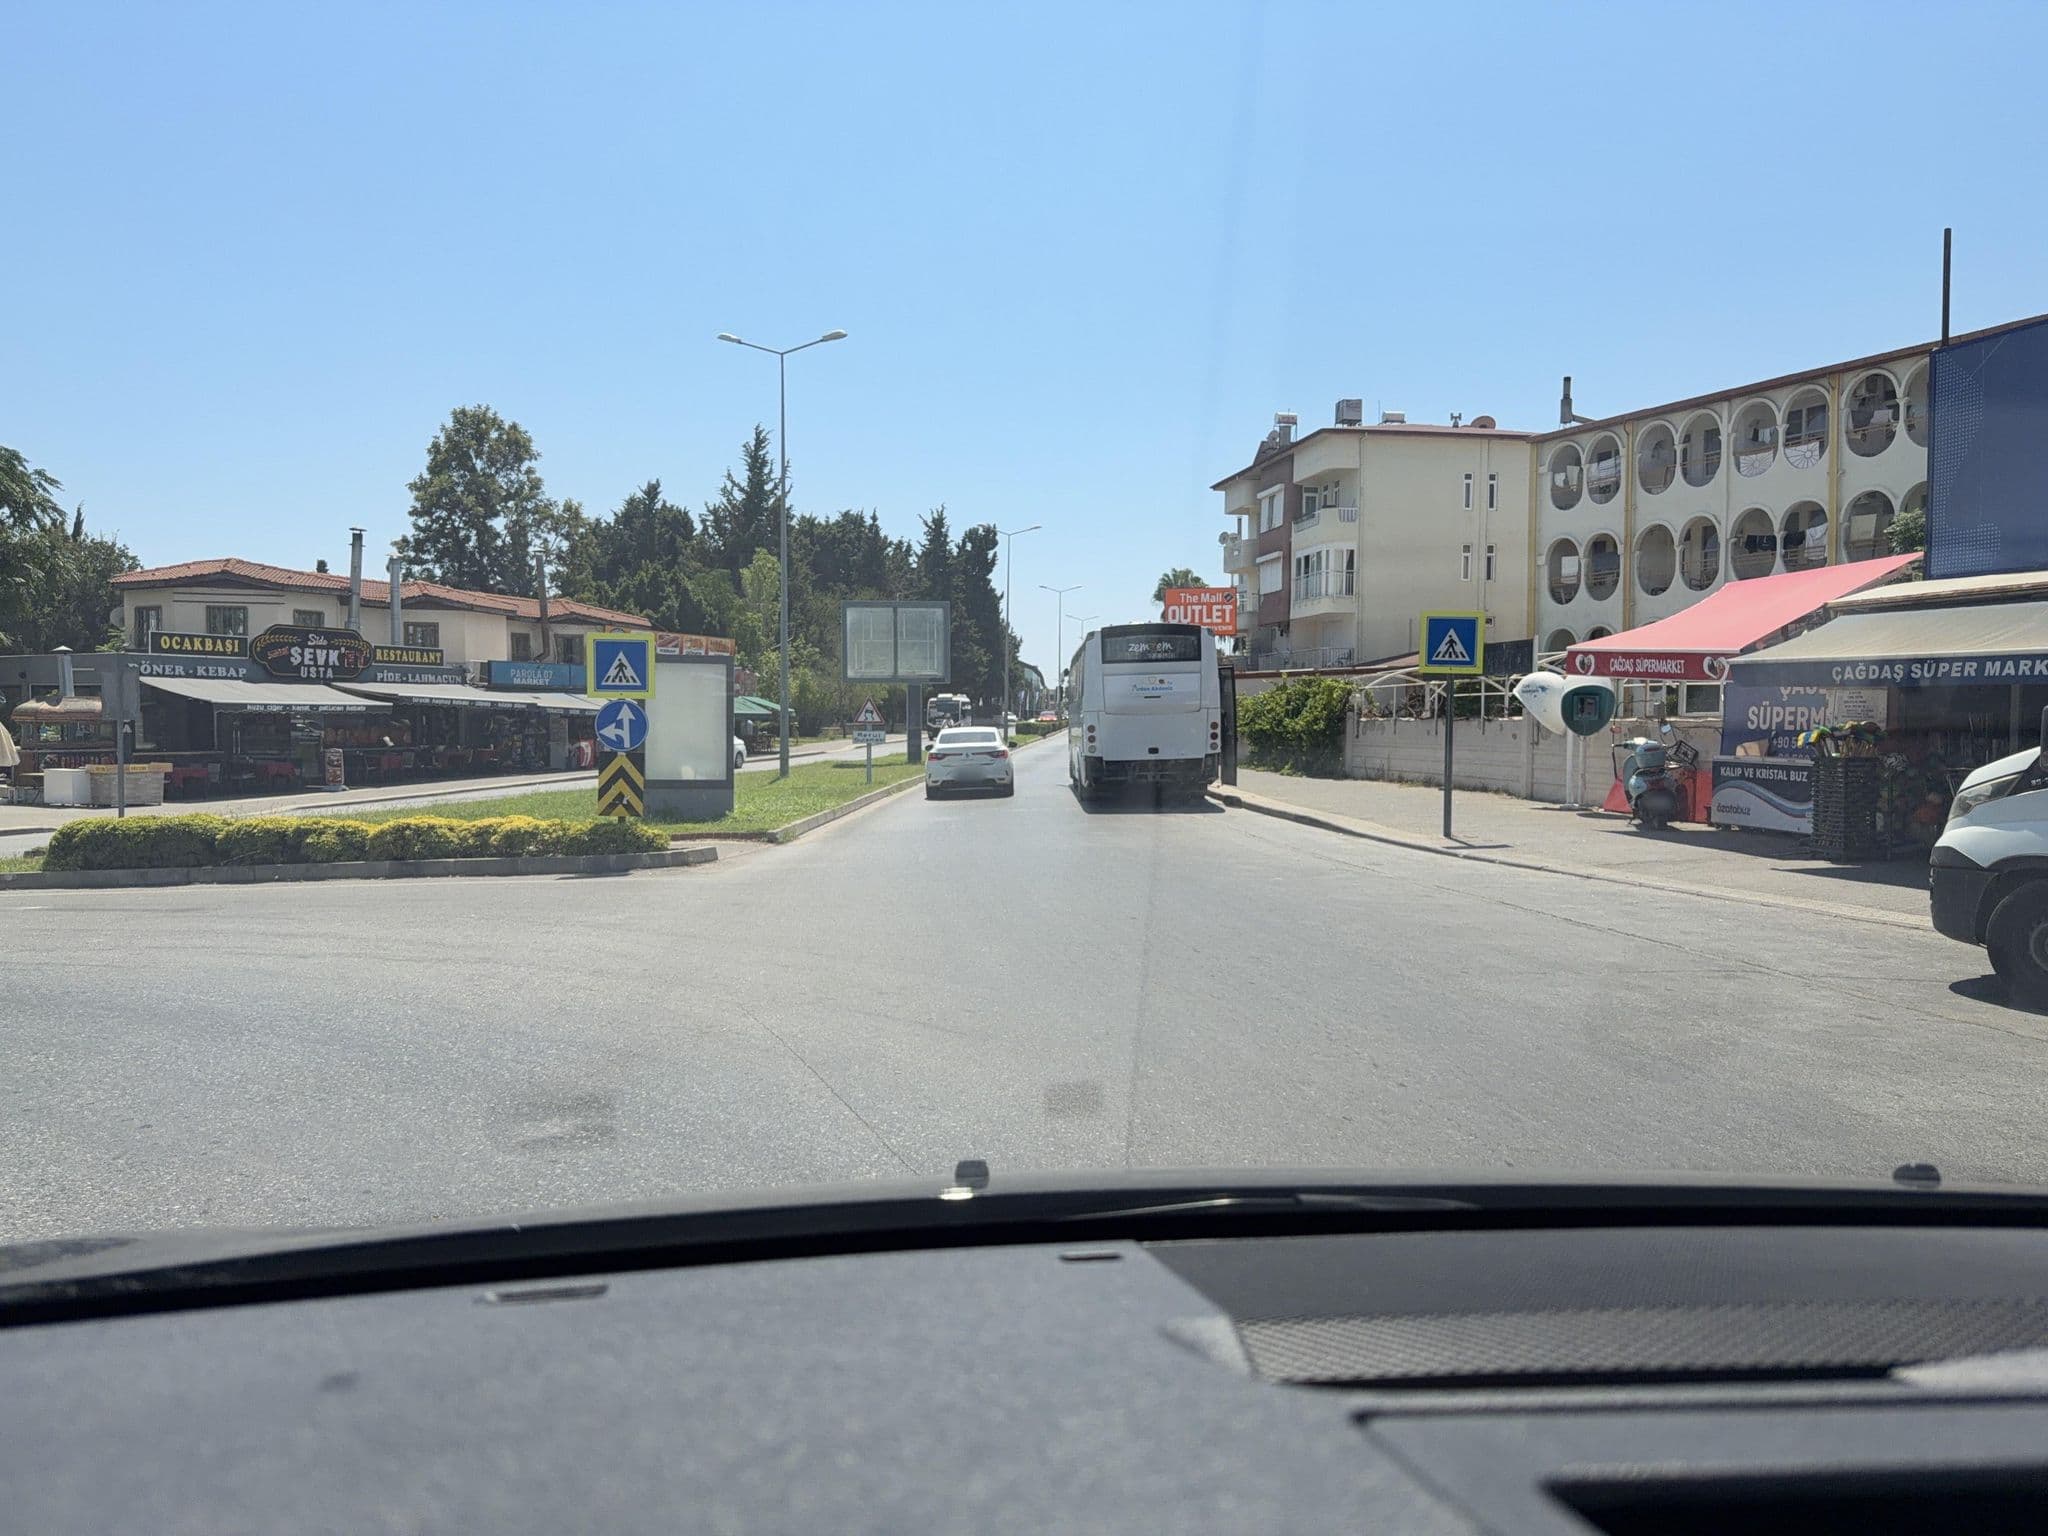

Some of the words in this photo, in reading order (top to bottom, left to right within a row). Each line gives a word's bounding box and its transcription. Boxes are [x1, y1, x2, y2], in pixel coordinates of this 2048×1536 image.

[1180, 592, 1198, 603] The
[1200, 592, 1222, 603] Mall
[1168, 604, 1233, 624] OUTLET
[160, 635, 240, 655] OCAKBAŞI
[375, 648, 442, 664] RESTAURANT
[196, 665, 247, 678] KEBAP
[300, 666, 334, 679] USTA
[1609, 655, 1634, 674] ÇAĞDAŞ
[1635, 656, 1685, 674] SÜPERMARKET
[1832, 662, 1904, 683] ÇAĞDAŞ
[1911, 660, 1978, 678] SÜPER
[376, 669, 402, 682] PİDE
[408, 672, 463, 685] LAHMACUN
[513, 677, 550, 686] MARKET
[1720, 766, 1742, 777] KALIP
[1744, 767, 1754, 778] VE
[1756, 766, 1788, 780] KRİSTAL
[1790, 771, 1809, 782] BUZ
